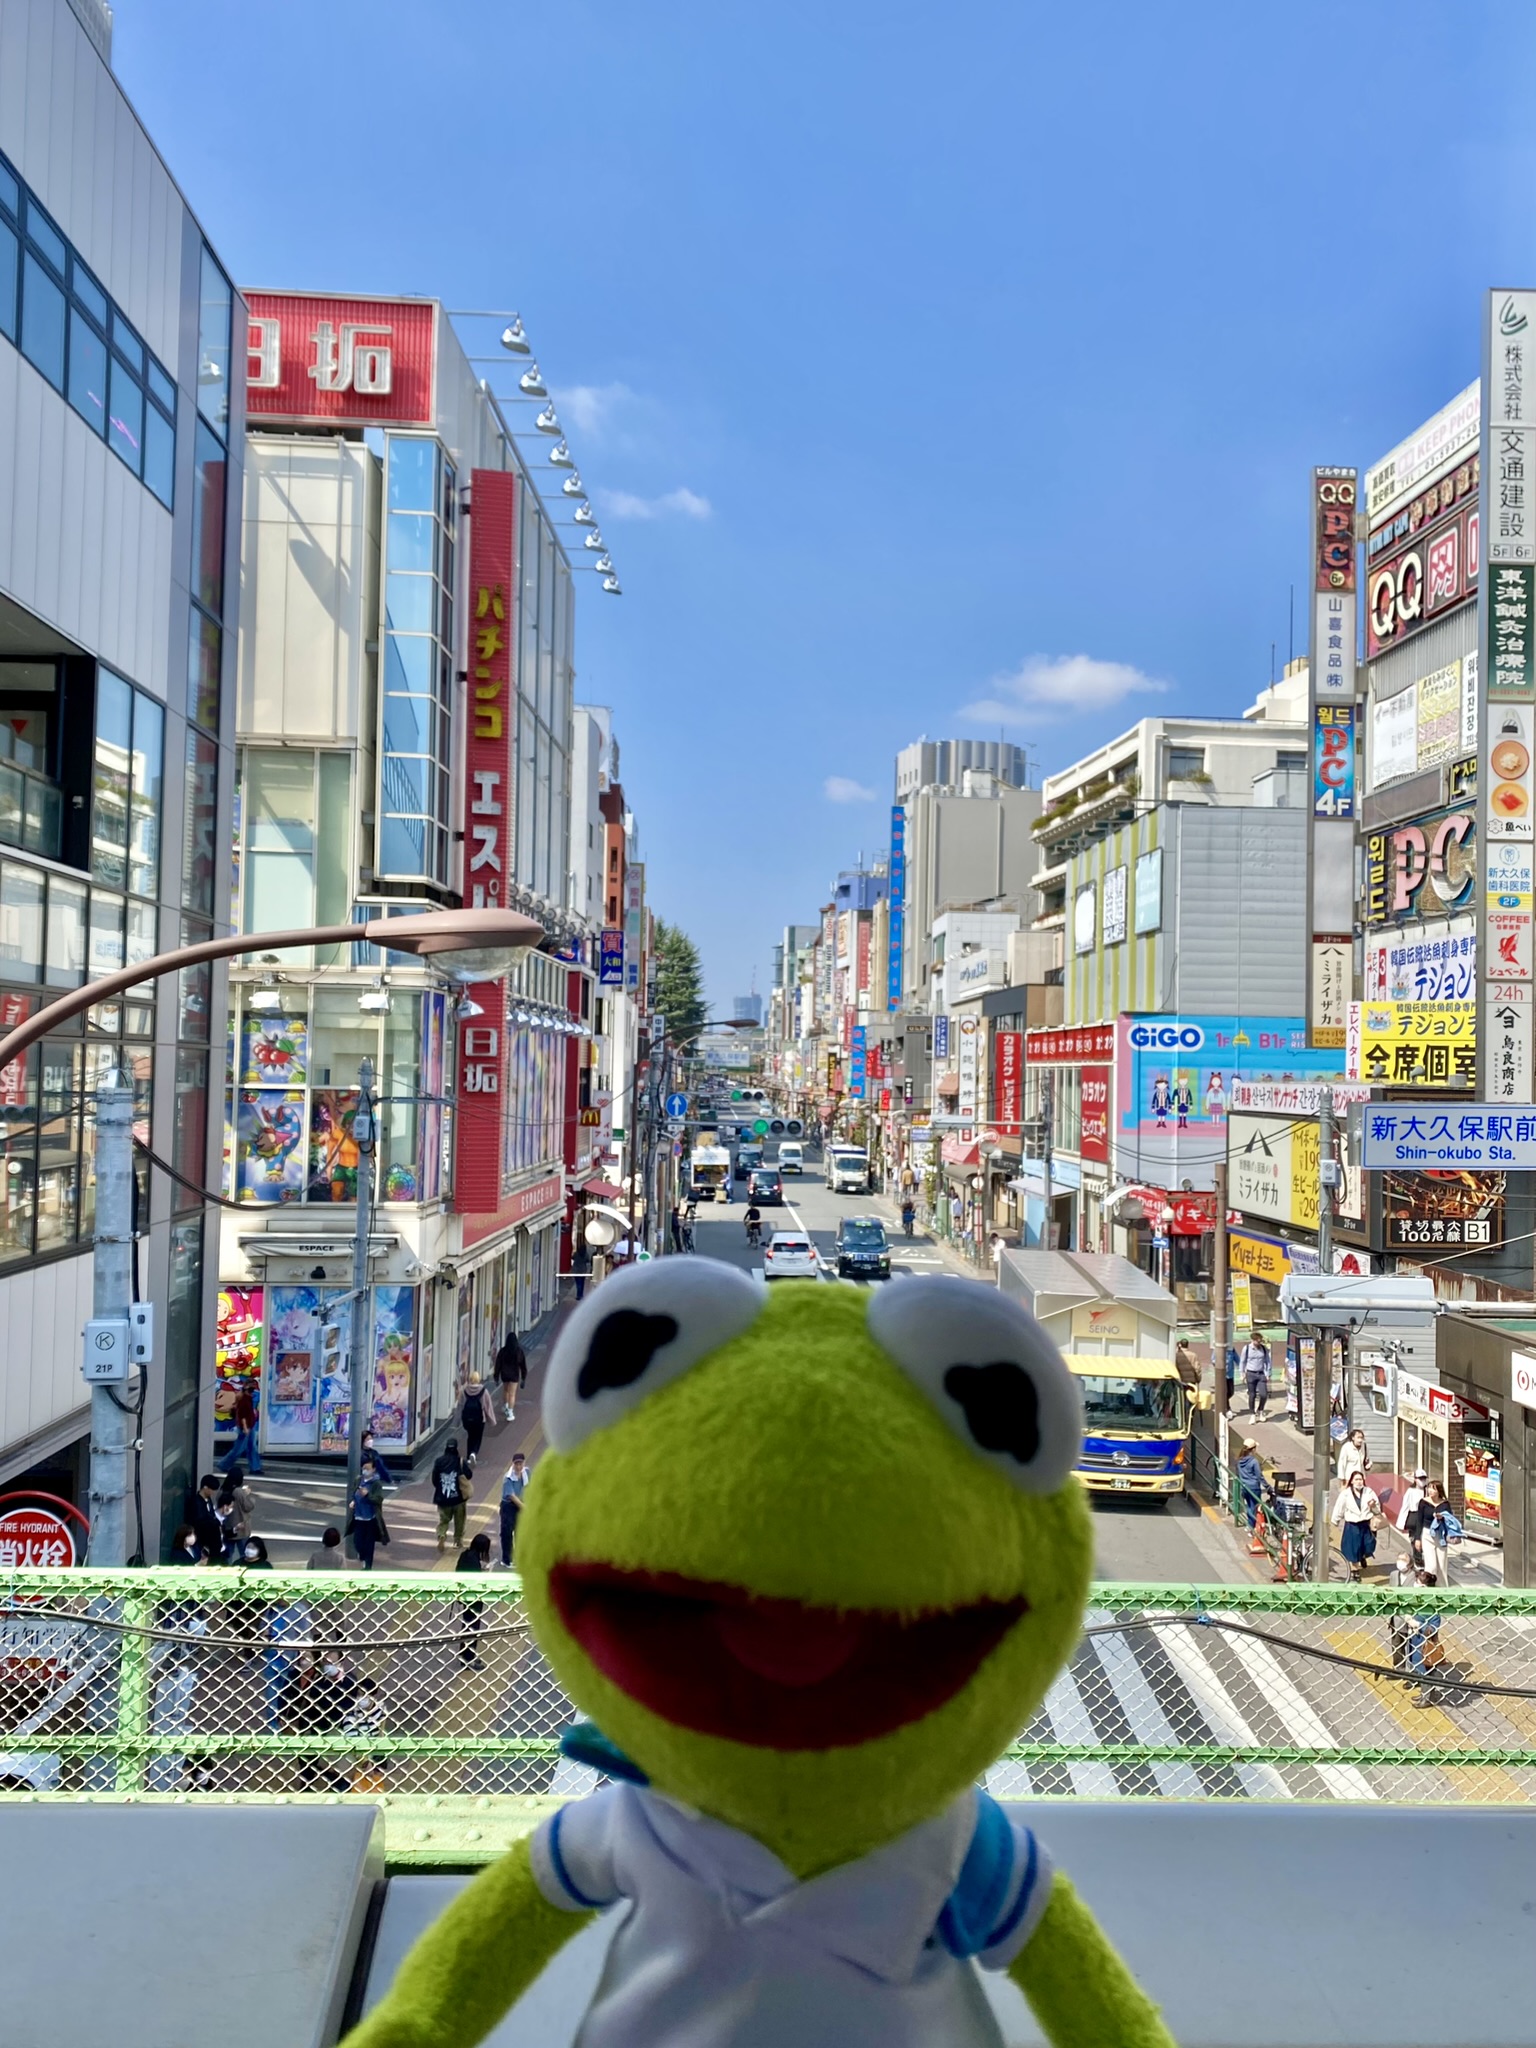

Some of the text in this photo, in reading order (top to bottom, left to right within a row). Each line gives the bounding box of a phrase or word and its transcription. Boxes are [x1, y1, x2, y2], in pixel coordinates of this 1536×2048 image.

[1504, 344, 1523, 420] 株式会社
[1319, 483, 1355, 504] QQ
[1500, 429, 1525, 538] 交通建設
[1493, 545, 1530, 558] 5F 6F
[1371, 552, 1422, 637] QQ
[1495, 569, 1527, 685] 東洋鍼灸治療院
[474, 583, 504, 738] パチンコ
[1317, 707, 1351, 725] 월드
[1320, 727, 1347, 787] PC
[1315, 788, 1351, 816] 4F
[1505, 821, 1532, 833] 魚べい
[470, 770, 502, 909] エスパ
[1393, 815, 1473, 910] PC
[1488, 868, 1531, 879] 新大久保
[1488, 881, 1531, 892] 歯科医院
[1503, 897, 1516, 906] 2F
[1488, 915, 1530, 924] COFFEE
[602, 932, 622, 954] 質
[604, 956, 621, 967] 大和
[1489, 967, 1528, 977] シュベール
[1321, 960, 1333, 1025] ミライザカ
[1415, 963, 1476, 1001] テジョン
[1494, 985, 1523, 1000] 24h
[1131, 1027, 1201, 1047] GiGO
[1216, 1033, 1230, 1047] 1F
[1259, 1033, 1287, 1048] B1F
[1348, 1005, 1358, 1080] エレベーター有
[463, 1027, 498, 1093] 日拓
[1003, 1035, 1015, 1077] カラオケ
[1365, 1043, 1476, 1083] 全席個室
[1082, 1081, 1107, 1103] カラオケ
[1300, 1087, 1320, 1109] 간장
[1371, 1116, 1536, 1142] 新大久保駅前
[1396, 1146, 1516, 1160] Shin-okubo Sta.
[1239, 1175, 1278, 1206] ミライザカ
[1292, 1175, 1320, 1196] 生ビール
[521, 1187, 544, 1212] ESPACE
[1399, 1220, 1461, 1232] 貸切最大
[1467, 1223, 1488, 1241] B1
[1398, 1231, 1461, 1243] 100名様
[299, 1244, 335, 1252] ESPACE
[1089, 1324, 1120, 1335] SEINO
[95, 1364, 113, 1373] 21P
[1435, 1401, 1469, 1418] 入口 3F
[0, 1522, 59, 1534] FIRE HYDRANT
